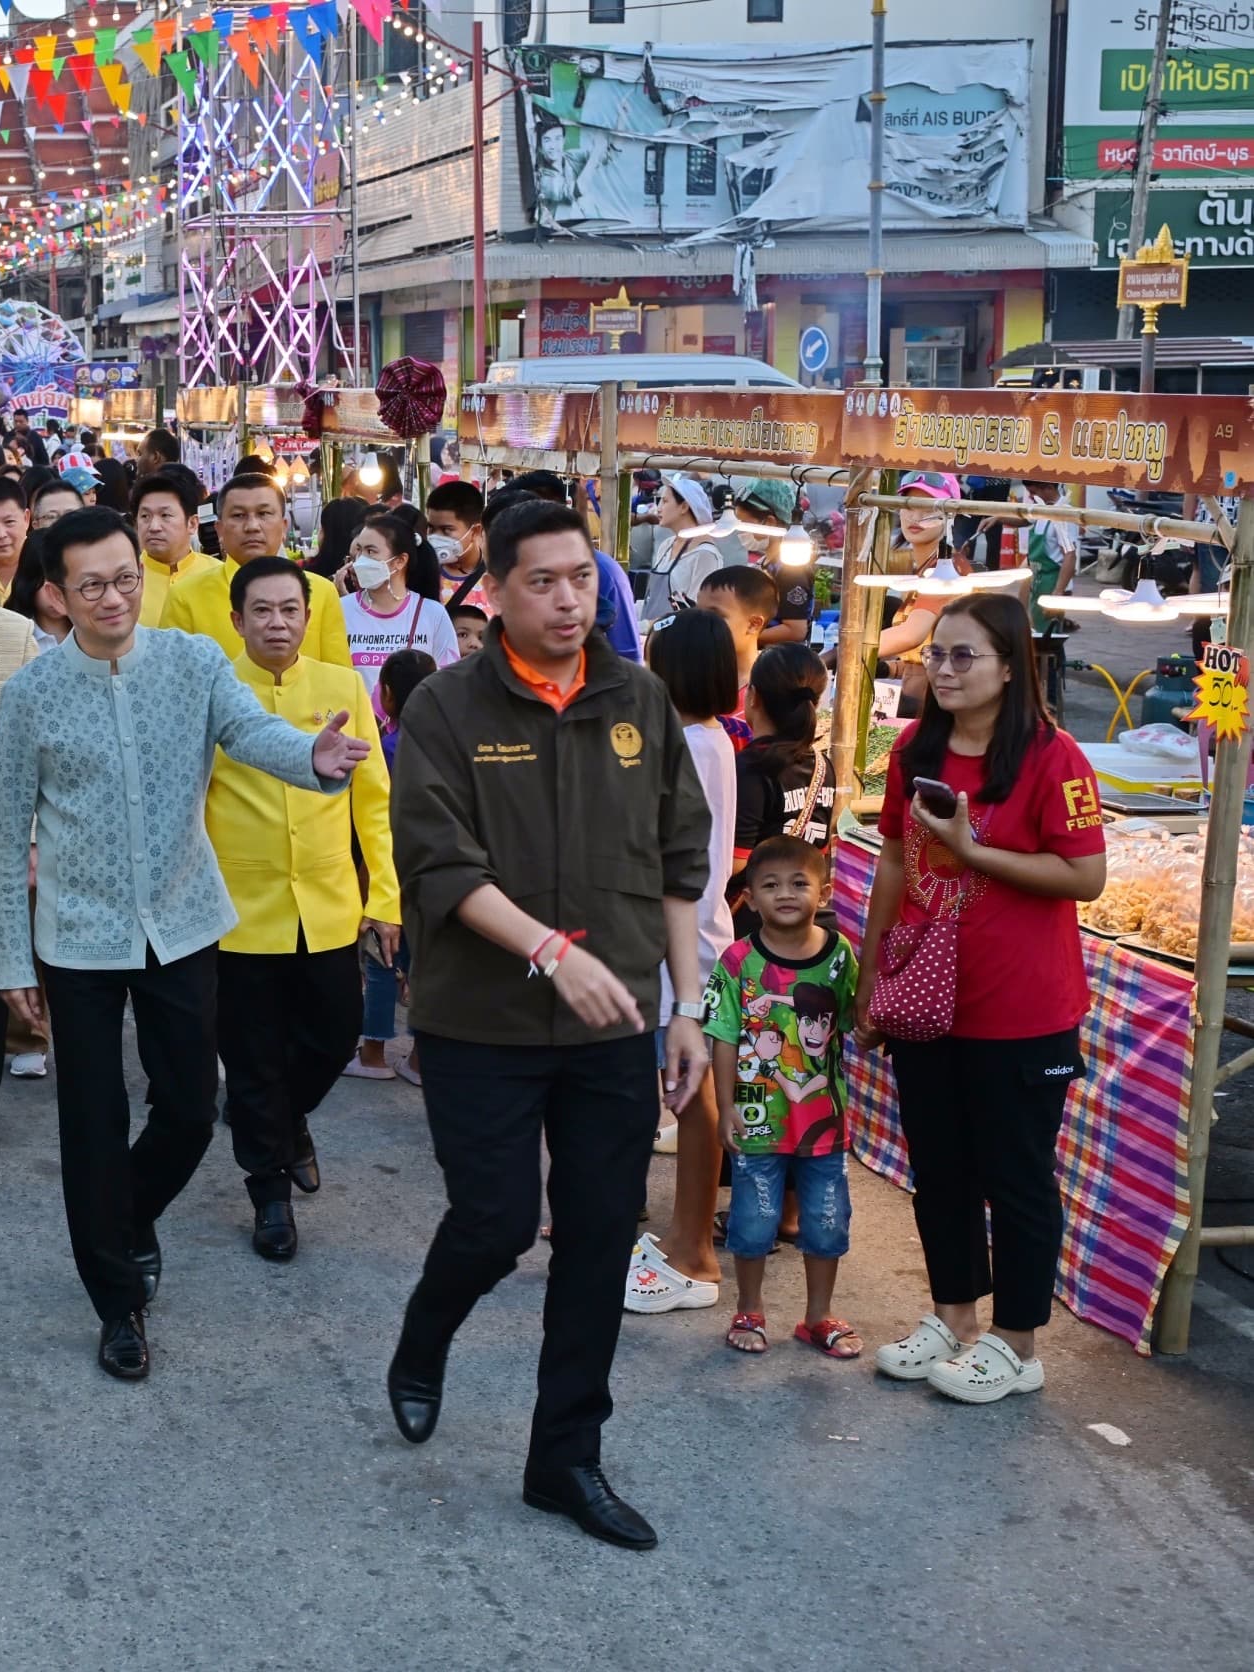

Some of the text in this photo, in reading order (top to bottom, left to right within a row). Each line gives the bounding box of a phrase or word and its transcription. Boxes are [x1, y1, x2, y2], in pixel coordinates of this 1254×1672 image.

[922, 112, 948, 126] AIS
[1214, 424, 1235, 438] A9
[347, 633, 428, 647] AKHONRATCHAIMA
[1205, 647, 1242, 673] HOT
[733, 1086, 764, 1103] EN
